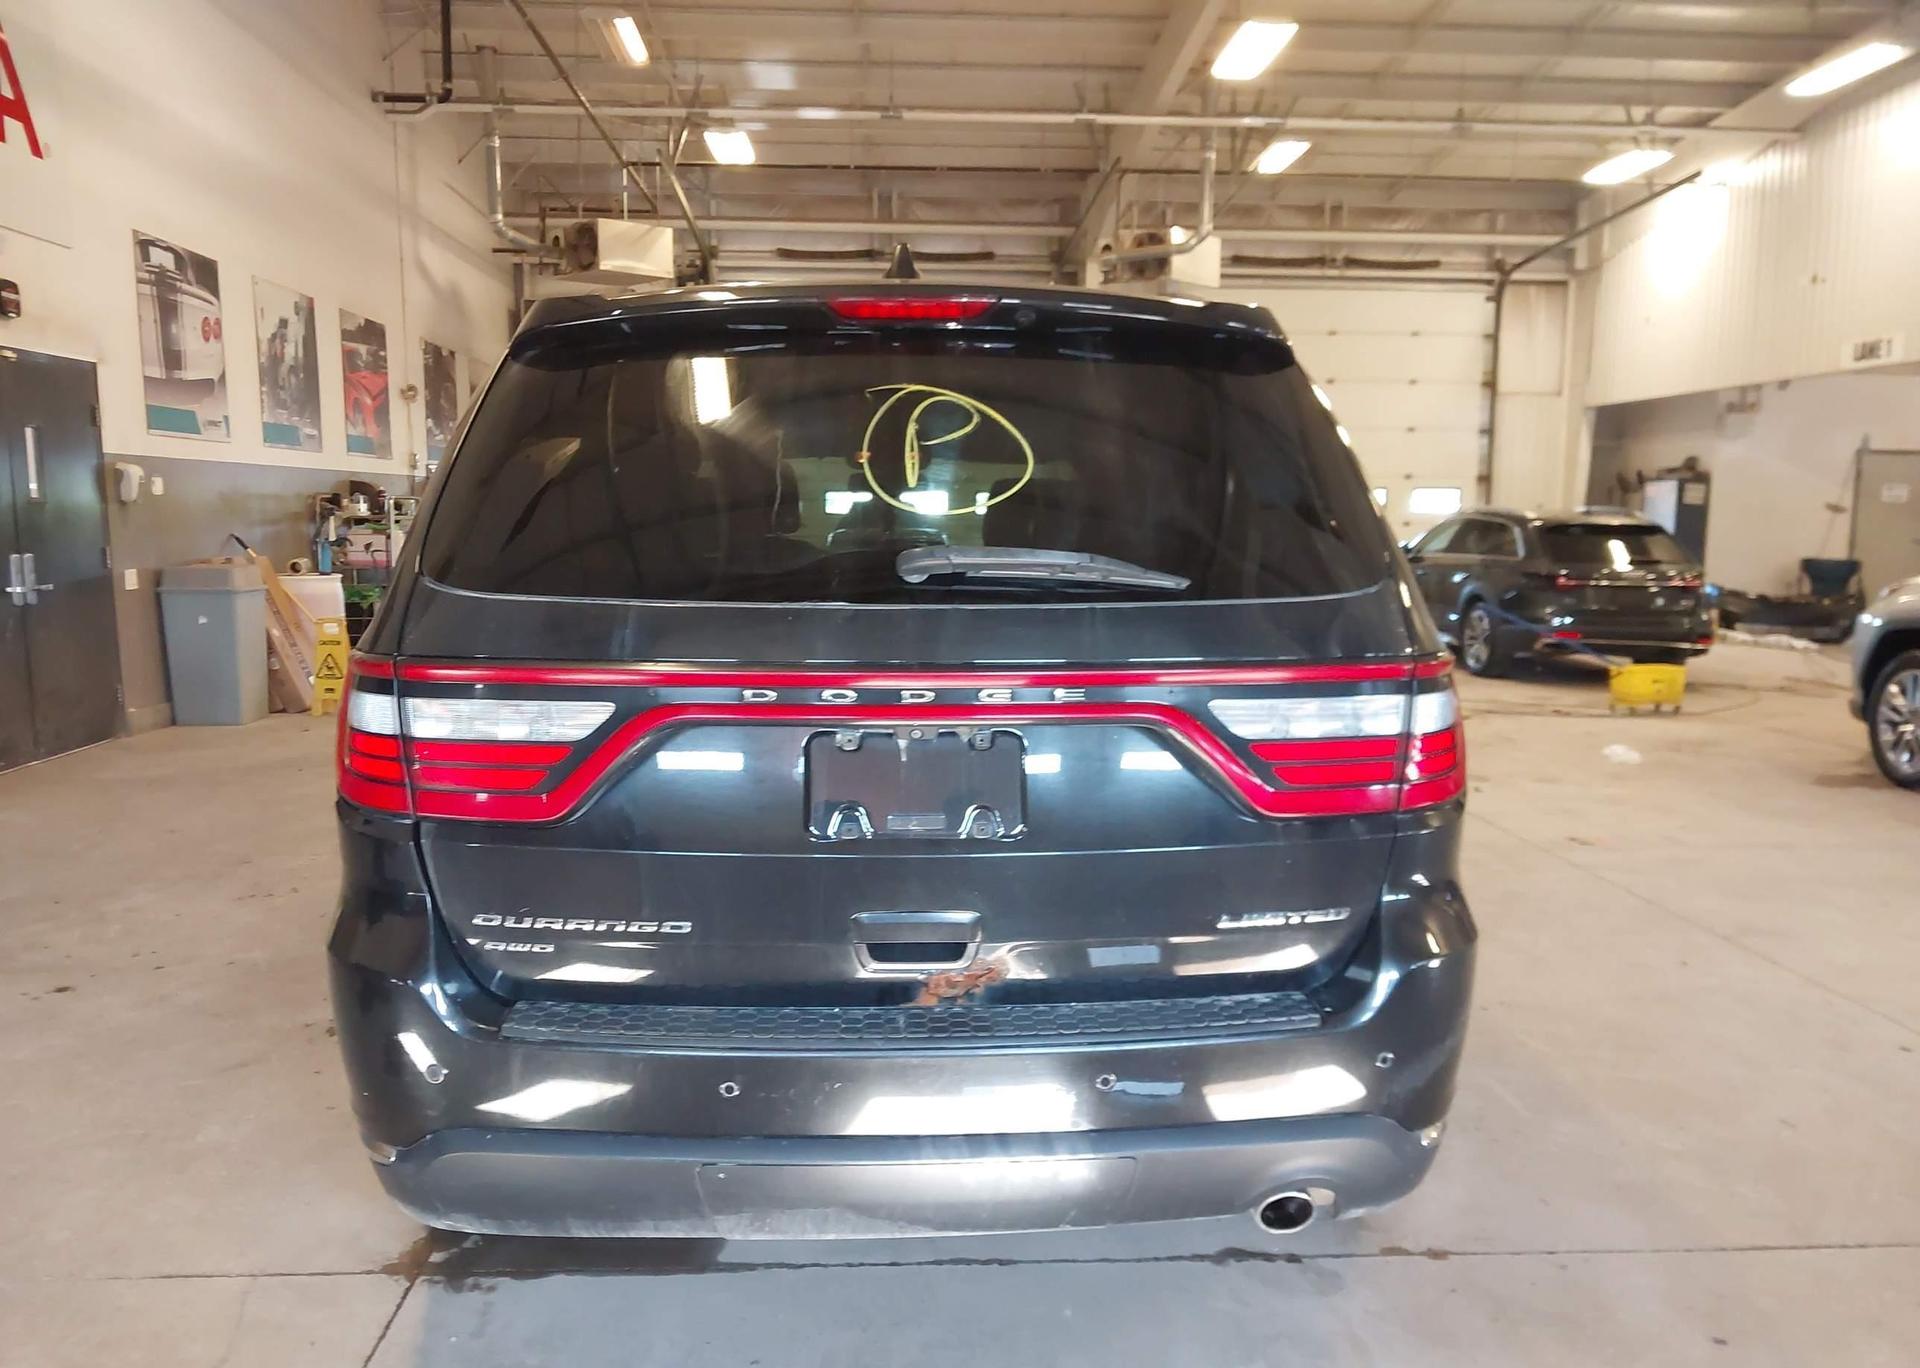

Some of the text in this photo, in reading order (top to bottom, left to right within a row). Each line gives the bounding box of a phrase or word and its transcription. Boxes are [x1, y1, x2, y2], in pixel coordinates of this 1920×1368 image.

[742, 687, 1086, 703] DODGE
[471, 913, 693, 934] DURANGO
[1215, 907, 1351, 930] LIMITED
[483, 941, 555, 953] AWD
